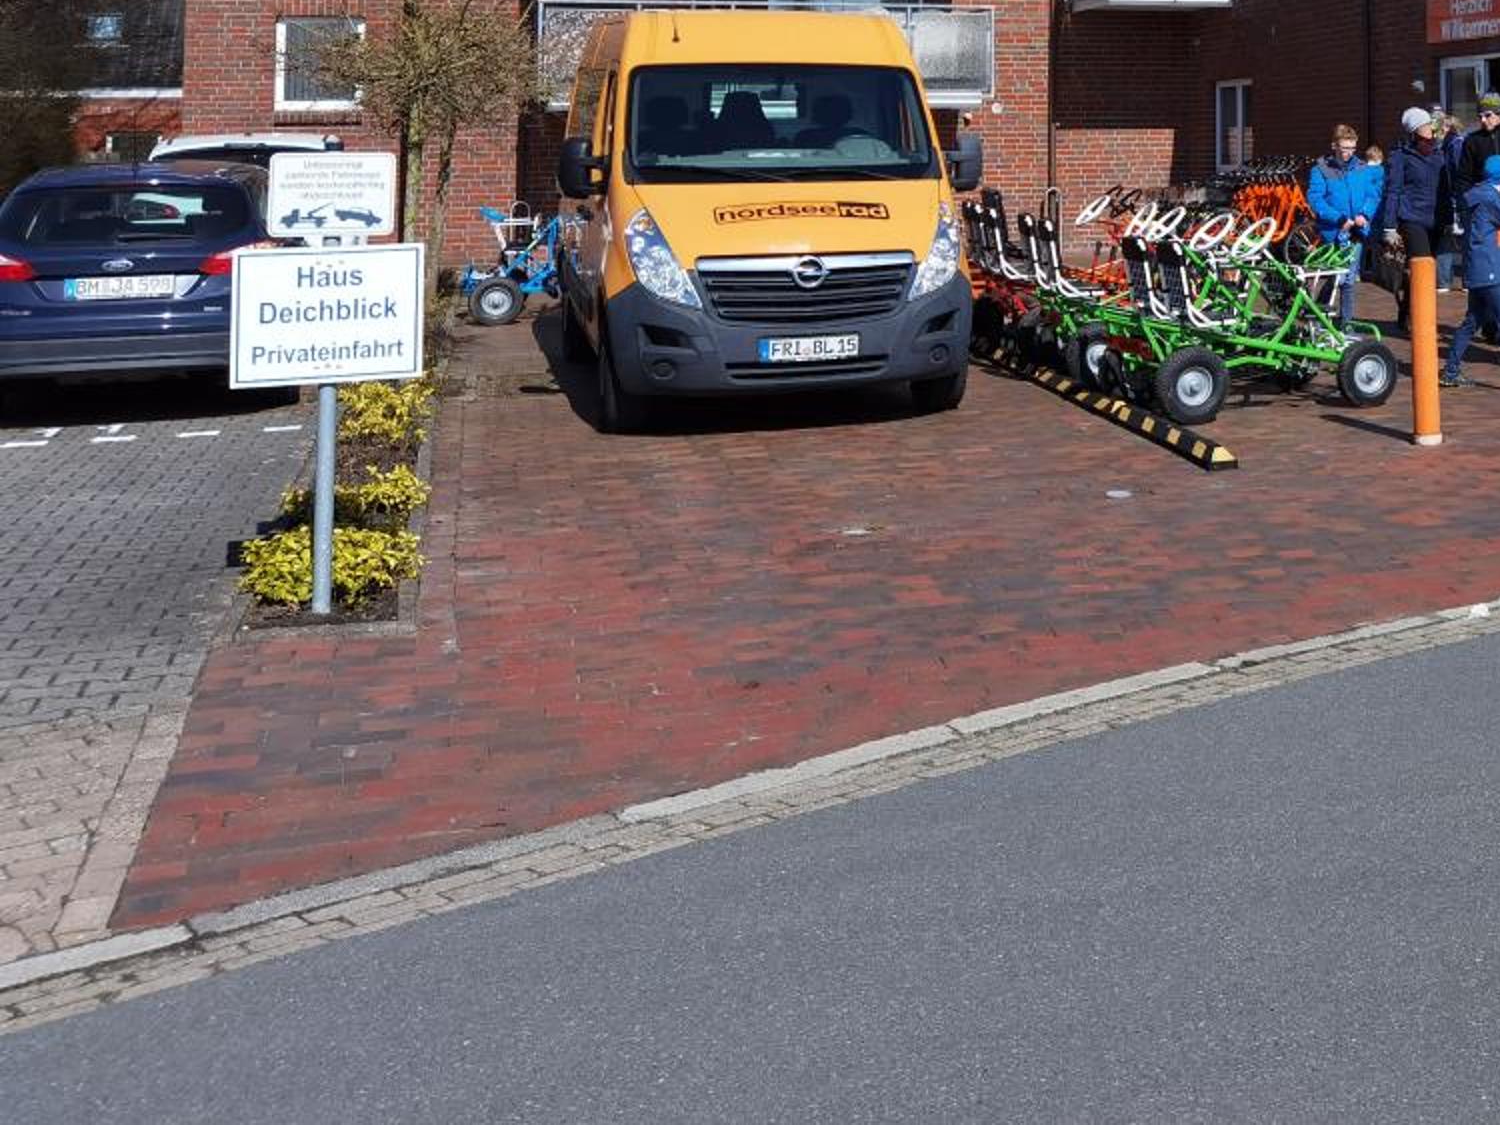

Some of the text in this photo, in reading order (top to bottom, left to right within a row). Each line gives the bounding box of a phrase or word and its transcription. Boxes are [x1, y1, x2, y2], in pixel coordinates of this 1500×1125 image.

[297, 265, 364, 289] Haus
[258, 296, 398, 325] Deichblick
[251, 338, 405, 365] Privateinfahrt
[771, 337, 857, 356] FRI BL 15
